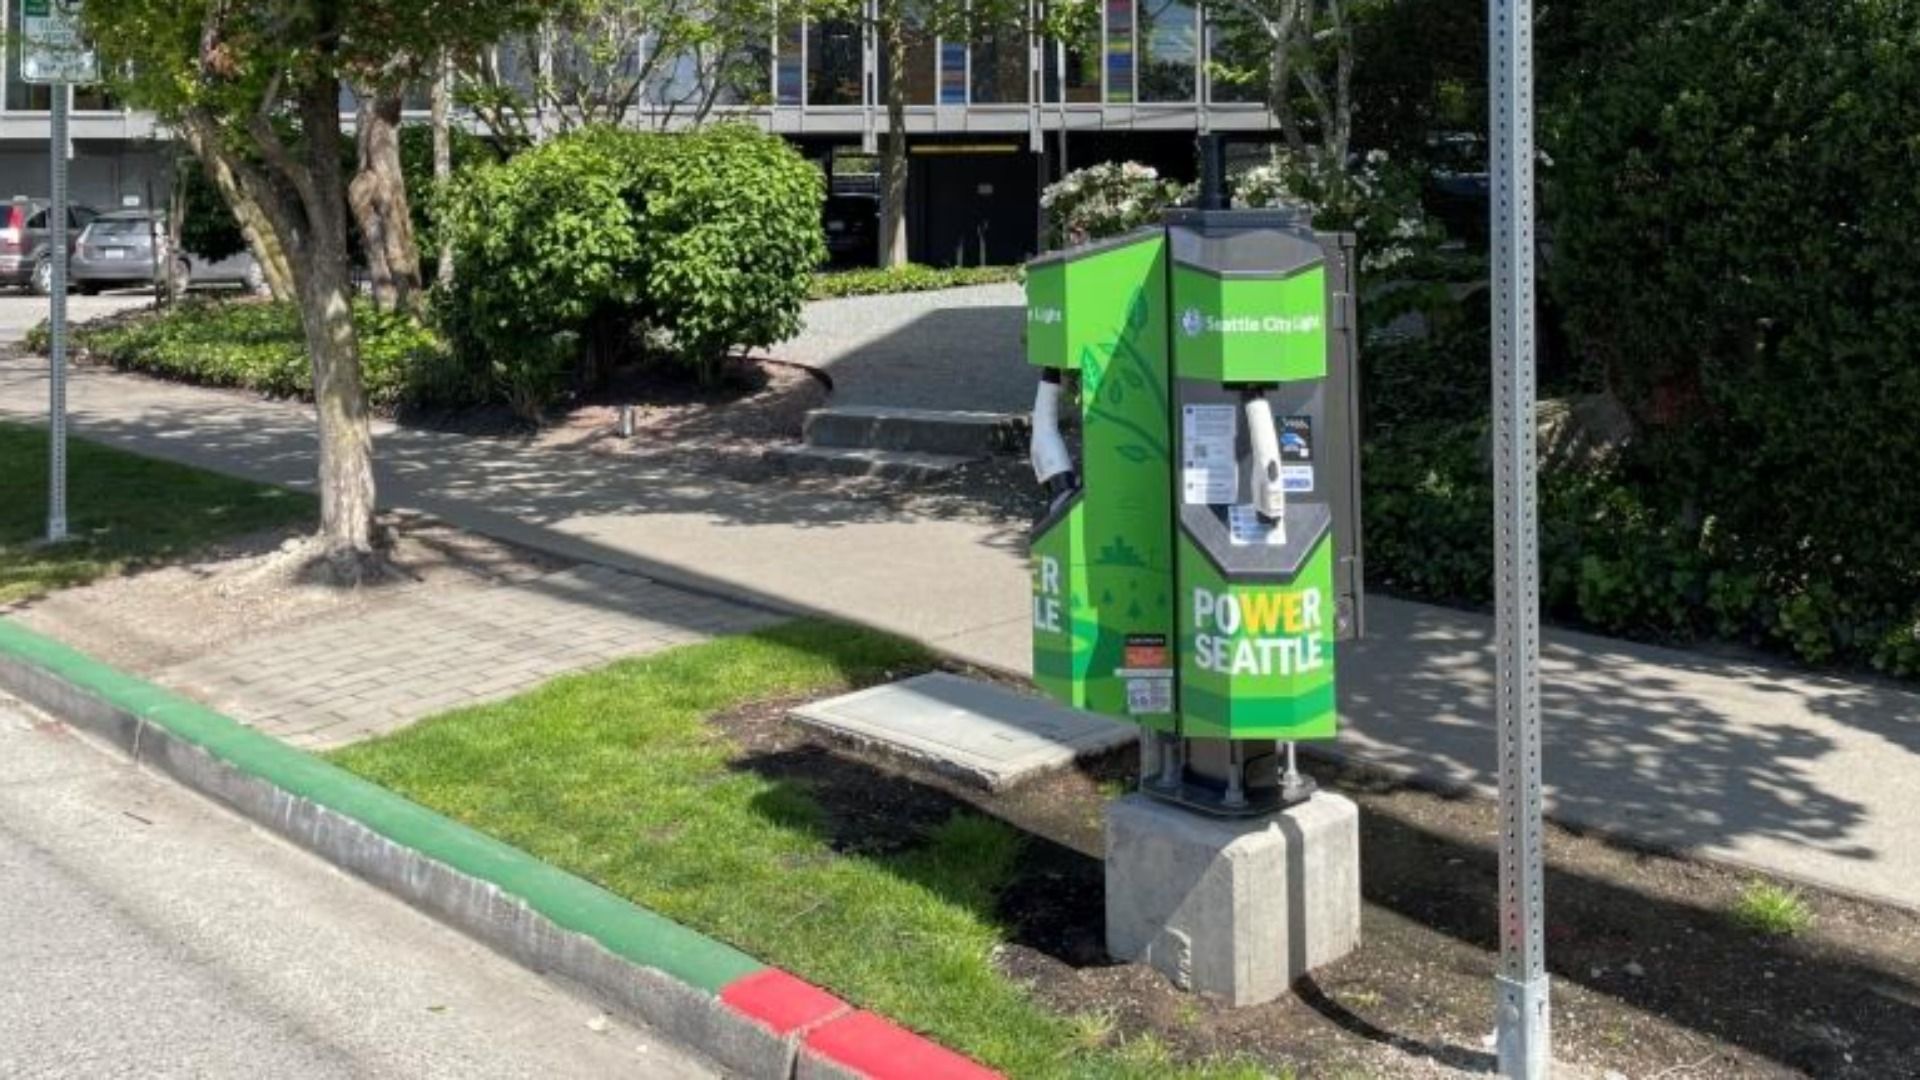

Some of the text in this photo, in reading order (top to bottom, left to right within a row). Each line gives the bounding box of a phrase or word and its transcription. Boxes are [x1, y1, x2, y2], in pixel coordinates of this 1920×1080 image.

[1206, 315, 1260, 332] Seattle
[1262, 315, 1293, 334] City
[1193, 587, 1322, 635] POWER
[1194, 632, 1324, 676] SEATTLE
